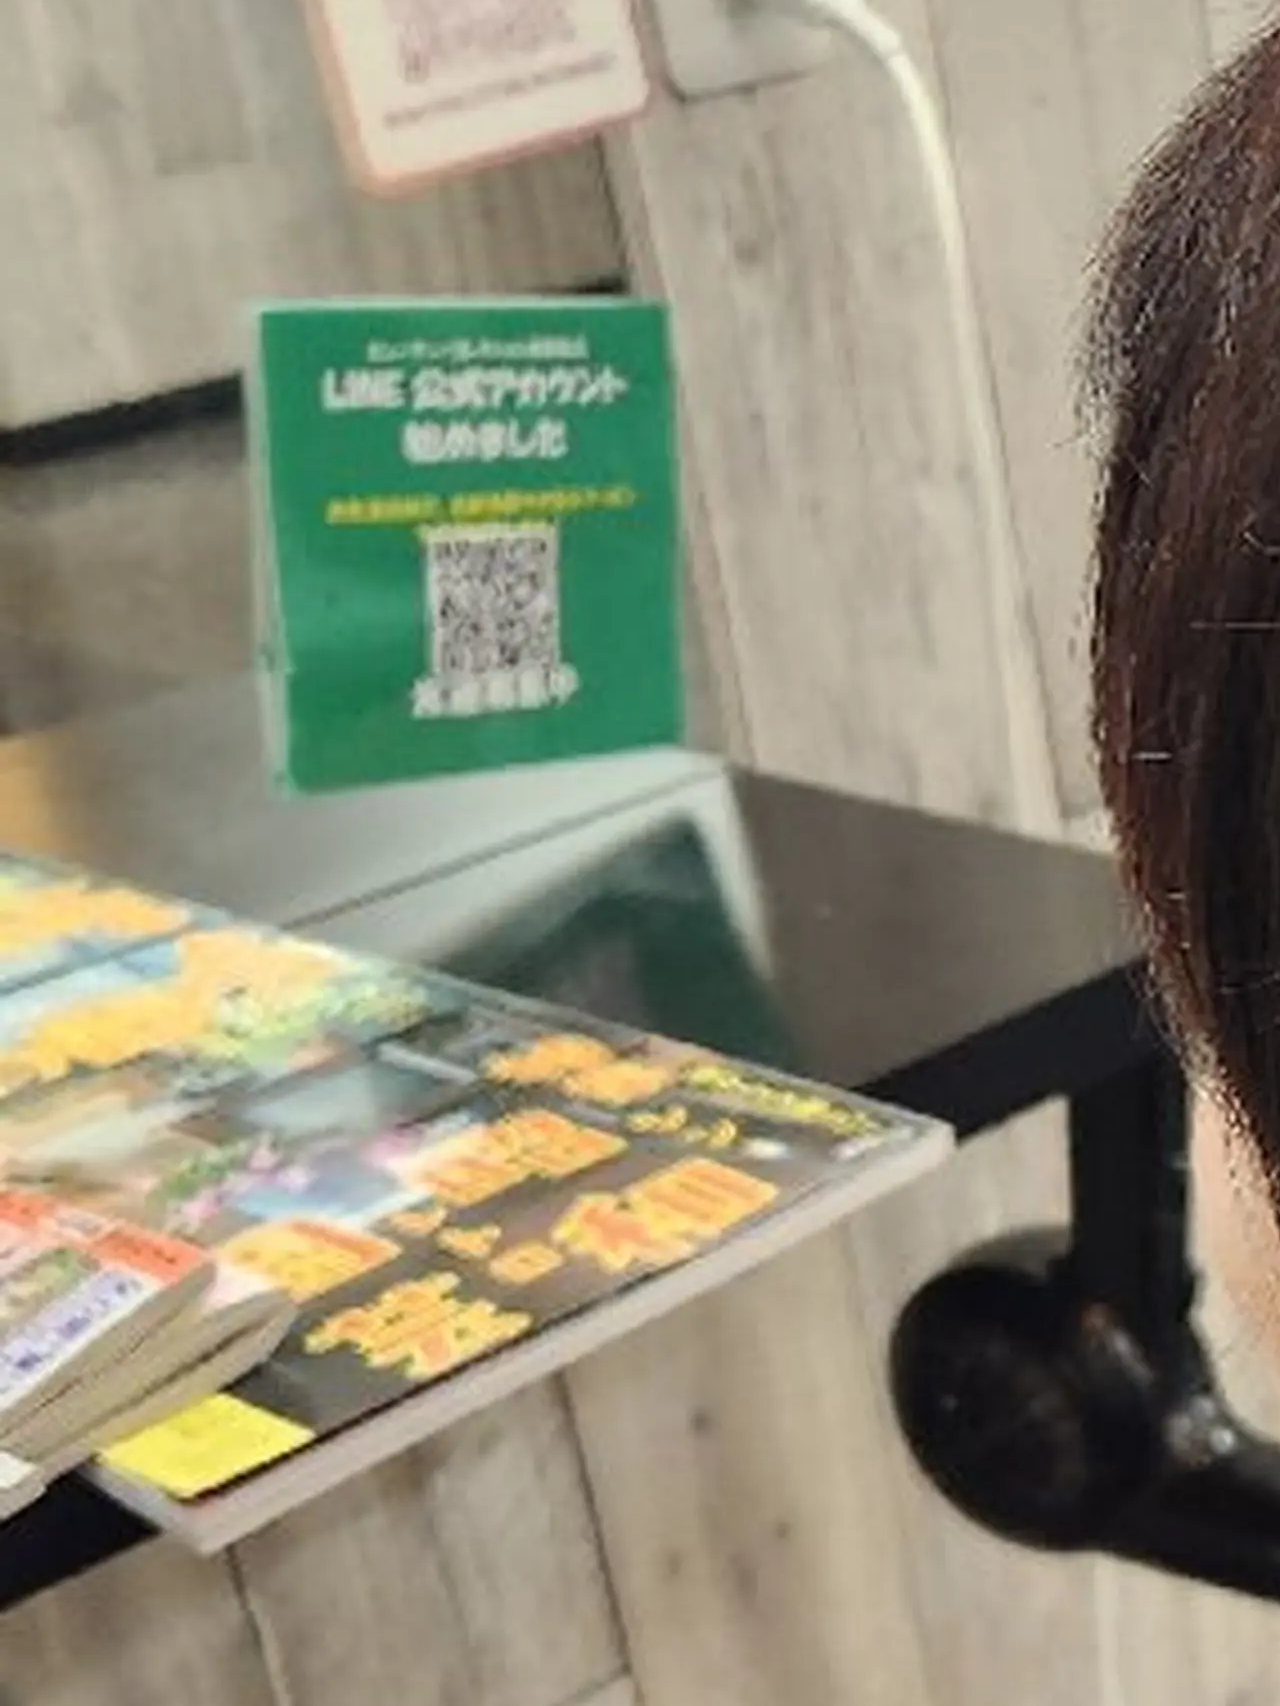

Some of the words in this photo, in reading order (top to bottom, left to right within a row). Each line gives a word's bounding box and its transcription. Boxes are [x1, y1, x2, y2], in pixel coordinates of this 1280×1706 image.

[321, 367, 404, 412] LINE
[411, 363, 629, 411] 公式アカウント
